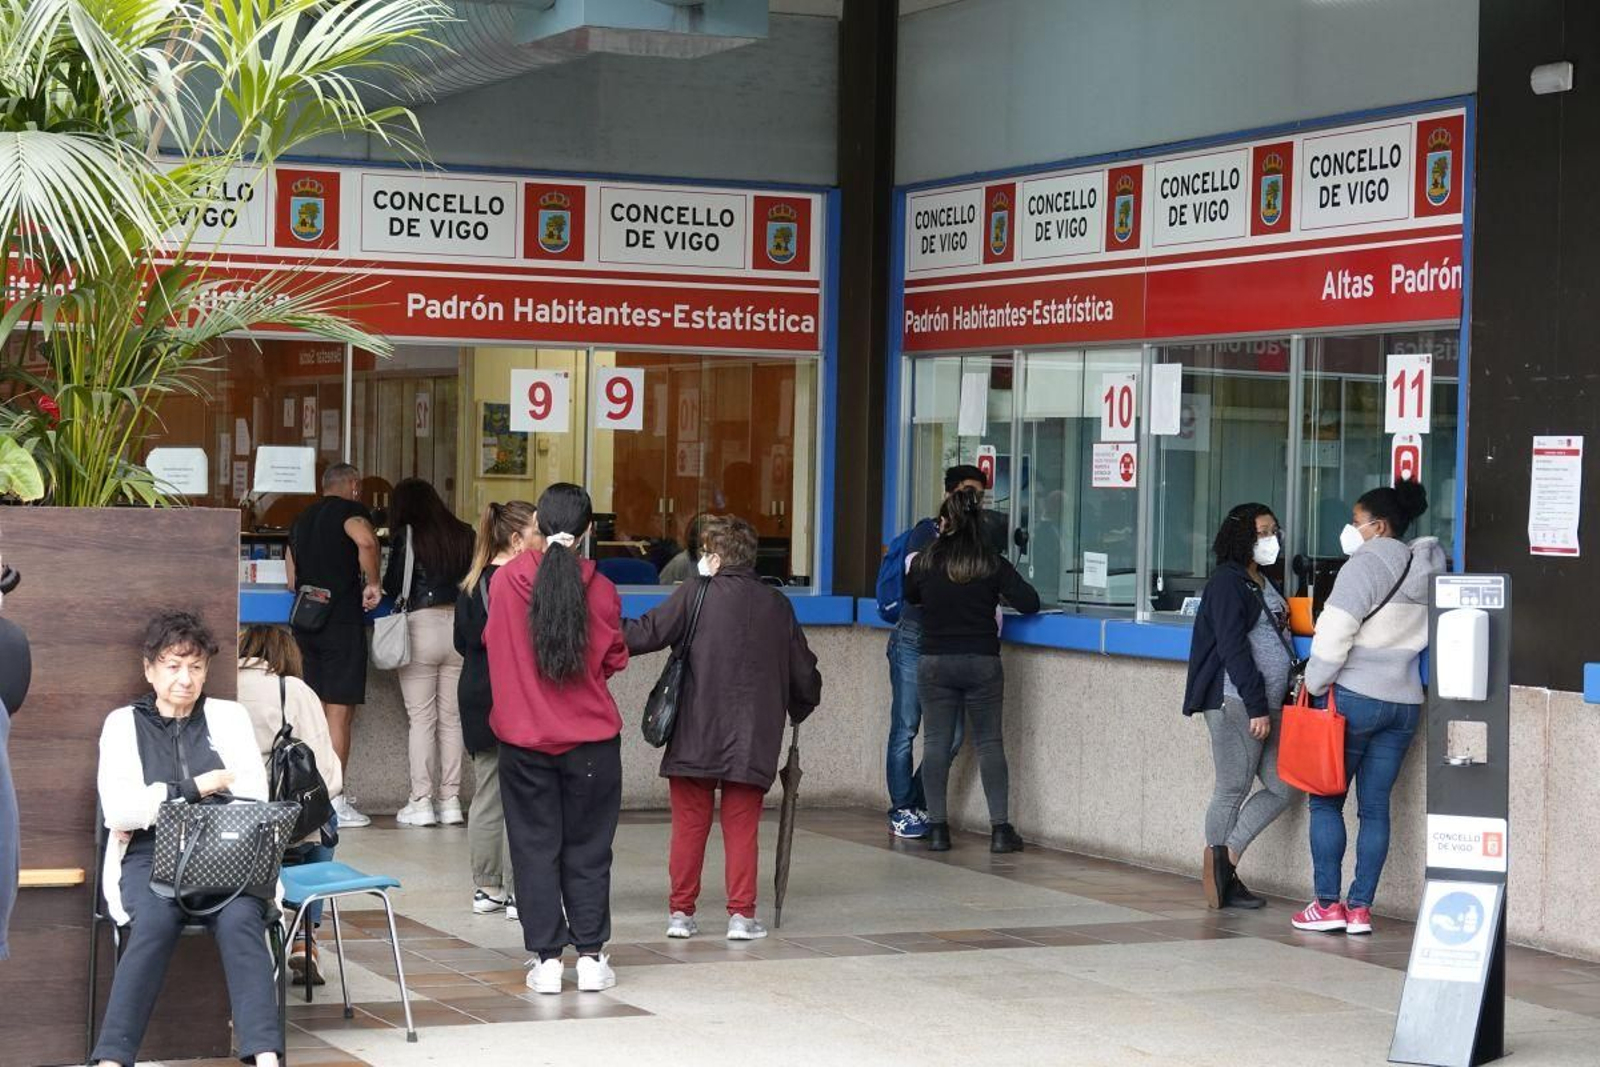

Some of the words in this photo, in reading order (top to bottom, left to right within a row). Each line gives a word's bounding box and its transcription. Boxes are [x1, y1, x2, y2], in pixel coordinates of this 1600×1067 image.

[1310, 144, 1402, 179] CONCELLO
[1160, 167, 1240, 200] CONCELLO
[1319, 184, 1341, 209] DE
[1346, 177, 1390, 204] VIGO
[373, 190, 505, 215] CONCELLO
[611, 203, 735, 228] CONCELLO
[1028, 187, 1097, 216] CONCELLO
[1168, 204, 1187, 227] DE
[1193, 199, 1230, 224] VIGO
[389, 217, 420, 238] DE
[430, 219, 489, 240] VIGO
[915, 204, 976, 230] CONCELLO
[1035, 221, 1051, 242] DE
[1056, 217, 1088, 239] VIGO
[625, 229, 655, 249] DE
[664, 231, 720, 252] VIGO
[921, 235, 936, 255] DE
[940, 231, 968, 252] VIGO
[1321, 269, 1374, 300] Altas
[1391, 257, 1462, 294] Padrón
[407, 292, 504, 321] Padrón
[514, 297, 815, 333] Habitantes-Estatística
[904, 305, 949, 334] Padrón
[953, 294, 1114, 331] Habitantes-Estatística
[528, 381, 553, 421] 9
[605, 376, 634, 420] 9
[1104, 385, 1133, 428] 10
[1393, 369, 1424, 418] 11
[1433, 832, 1481, 842] CONCELLO
[1438, 842, 1449, 850] DE
[1452, 843, 1473, 852] VIGO
